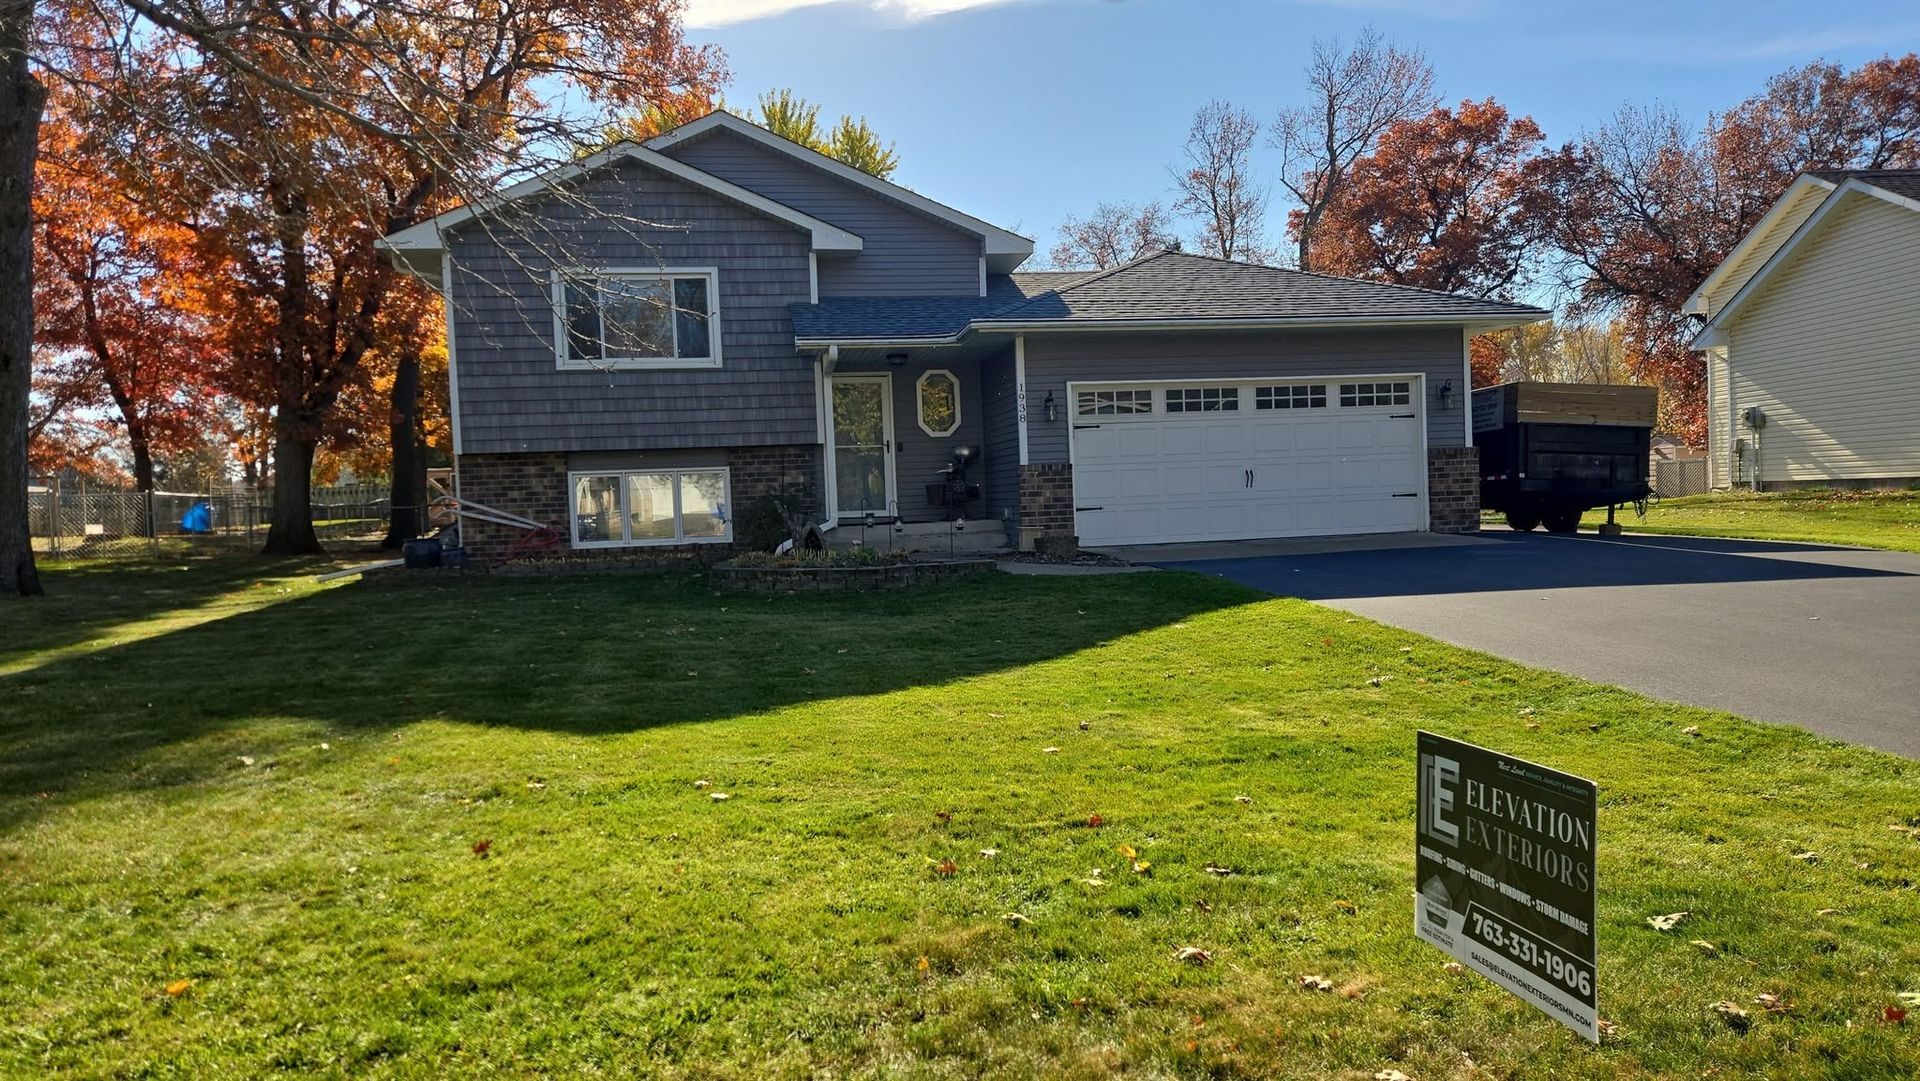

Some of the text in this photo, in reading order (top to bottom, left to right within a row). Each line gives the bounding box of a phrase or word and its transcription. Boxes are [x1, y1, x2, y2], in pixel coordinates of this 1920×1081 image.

[1466, 778, 1590, 851] ELEVATION
[1465, 816, 1589, 893] EXTERIORS
[1469, 867, 1495, 889] GUTTERS
[1499, 882, 1531, 907] WINDOWS
[1536, 899, 1559, 919] STORM
[1559, 910, 1589, 936] DAMAGE
[1471, 951, 1592, 1030] SALES@ELEVATIONEXTERIORSMN.COM
[1472, 912, 1591, 996] 763-331-1906
